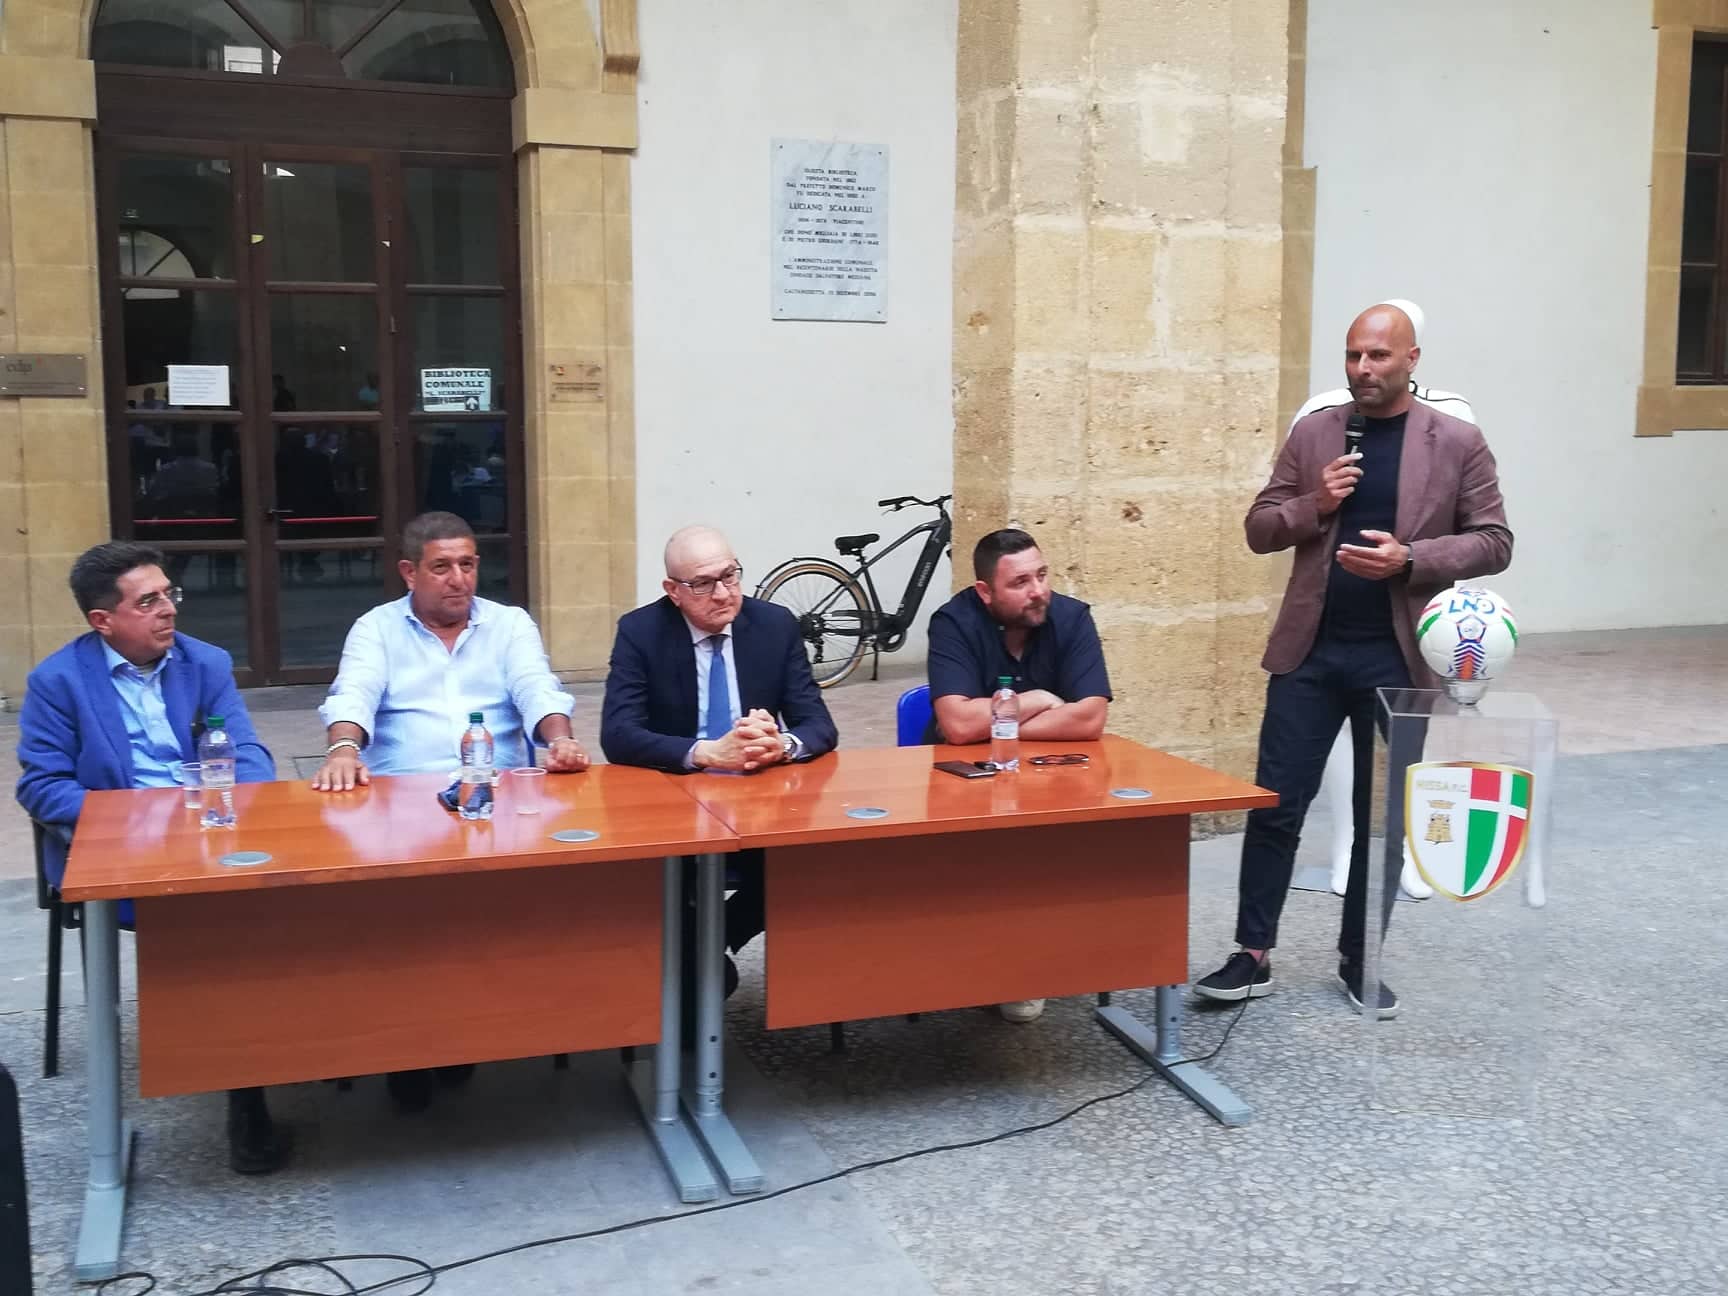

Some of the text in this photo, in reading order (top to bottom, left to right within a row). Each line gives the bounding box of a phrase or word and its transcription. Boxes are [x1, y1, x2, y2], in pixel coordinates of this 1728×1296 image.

[789, 202, 873, 213] LUCIANO SCARABELLI
[423, 370, 493, 378] BIBLIOTECA
[425, 380, 485, 388] COMUNALE
